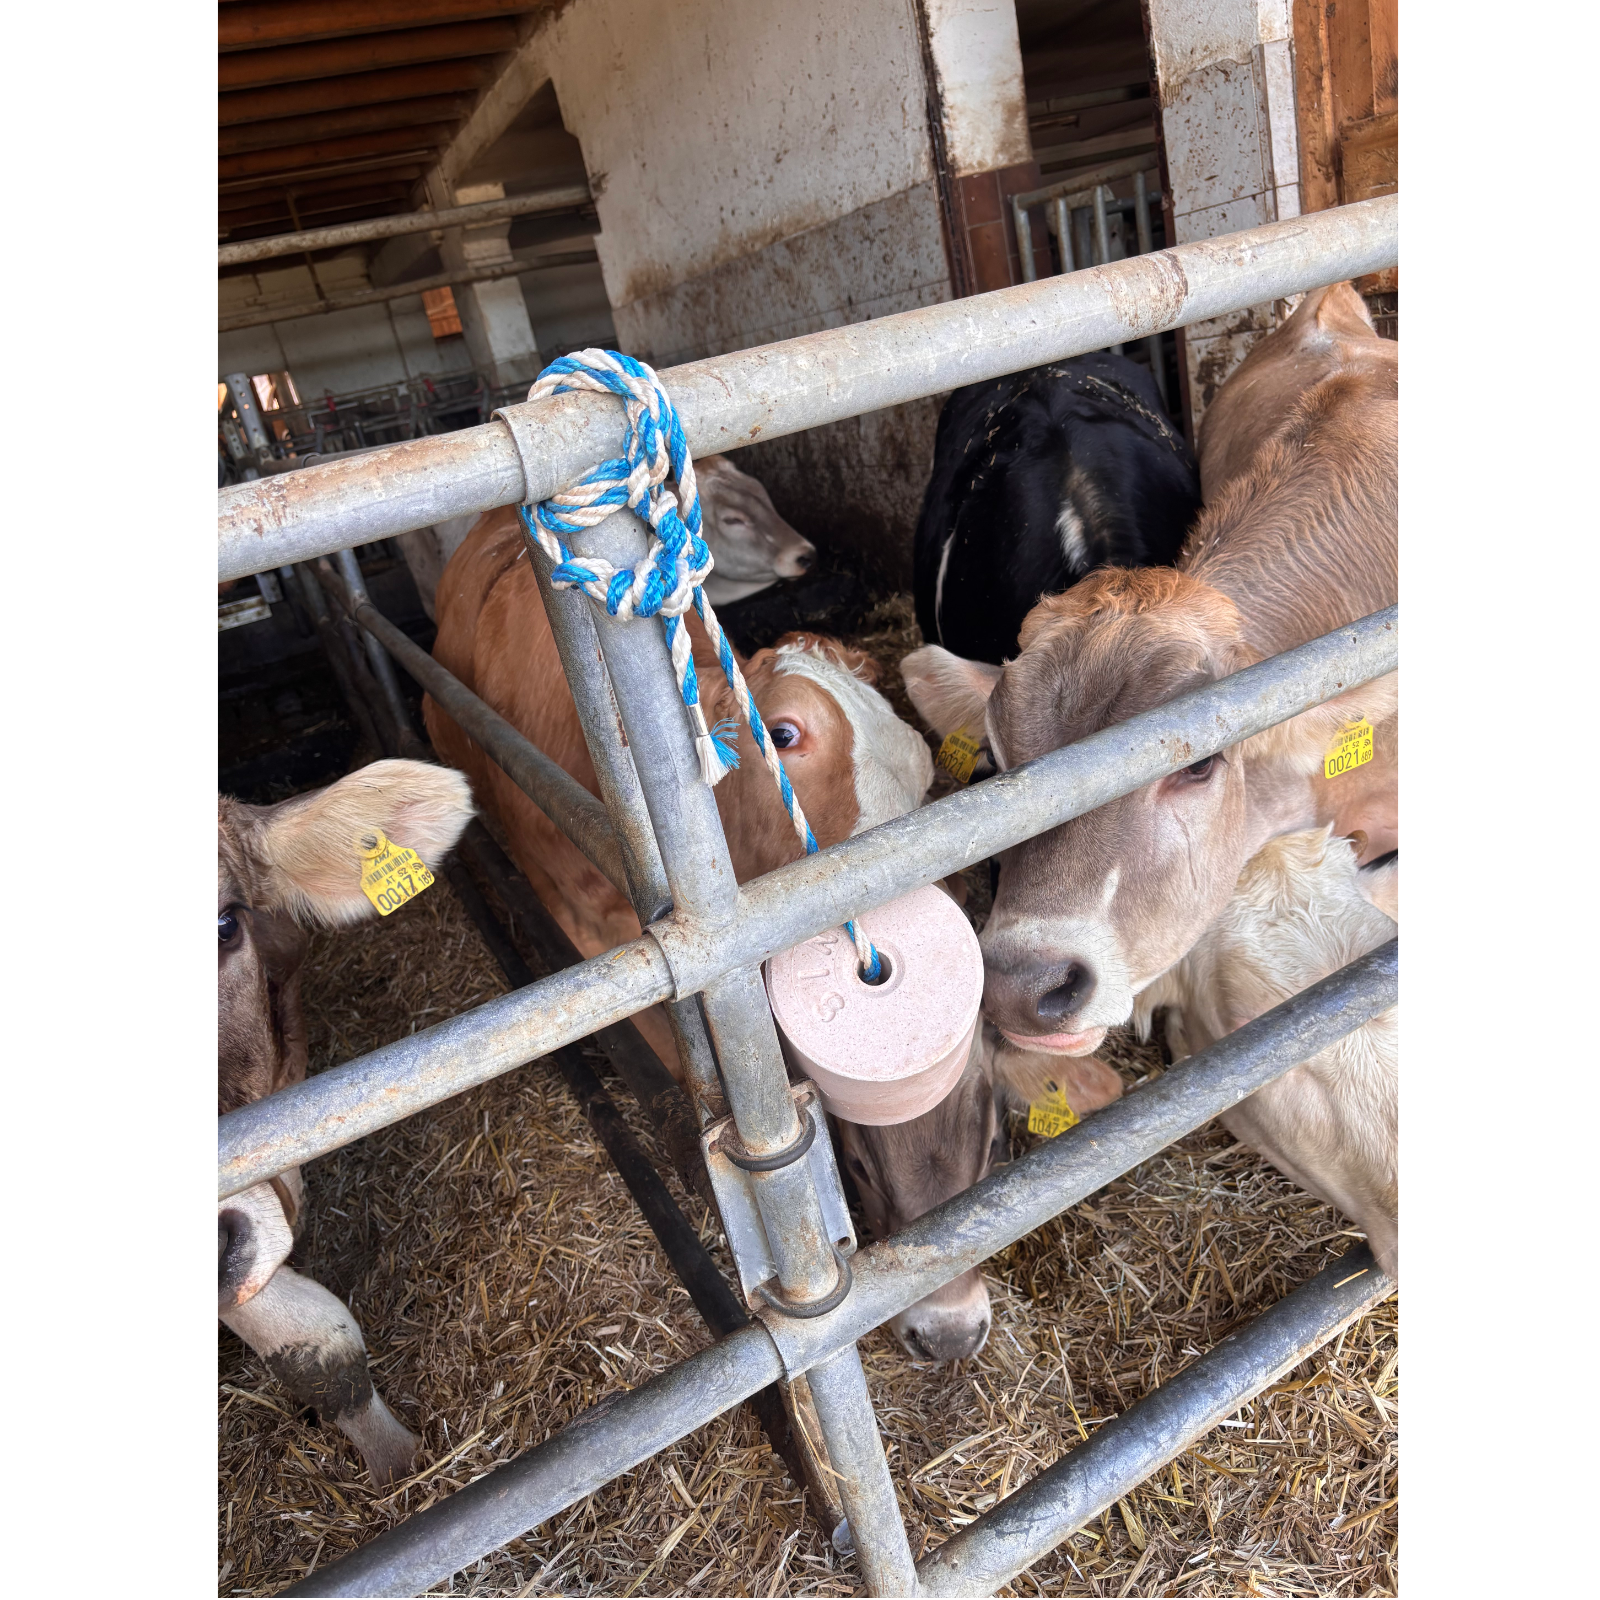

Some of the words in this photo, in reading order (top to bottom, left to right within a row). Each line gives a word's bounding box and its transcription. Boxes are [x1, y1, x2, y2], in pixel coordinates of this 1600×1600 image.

[1342, 745, 1349, 753] AT
[1328, 748, 1359, 776] 0021
[385, 875, 396, 886] AT
[397, 867, 408, 878] 52
[377, 874, 416, 911] 0017
[418, 871, 433, 887] 189
[1032, 1116, 1059, 1137] 1047
